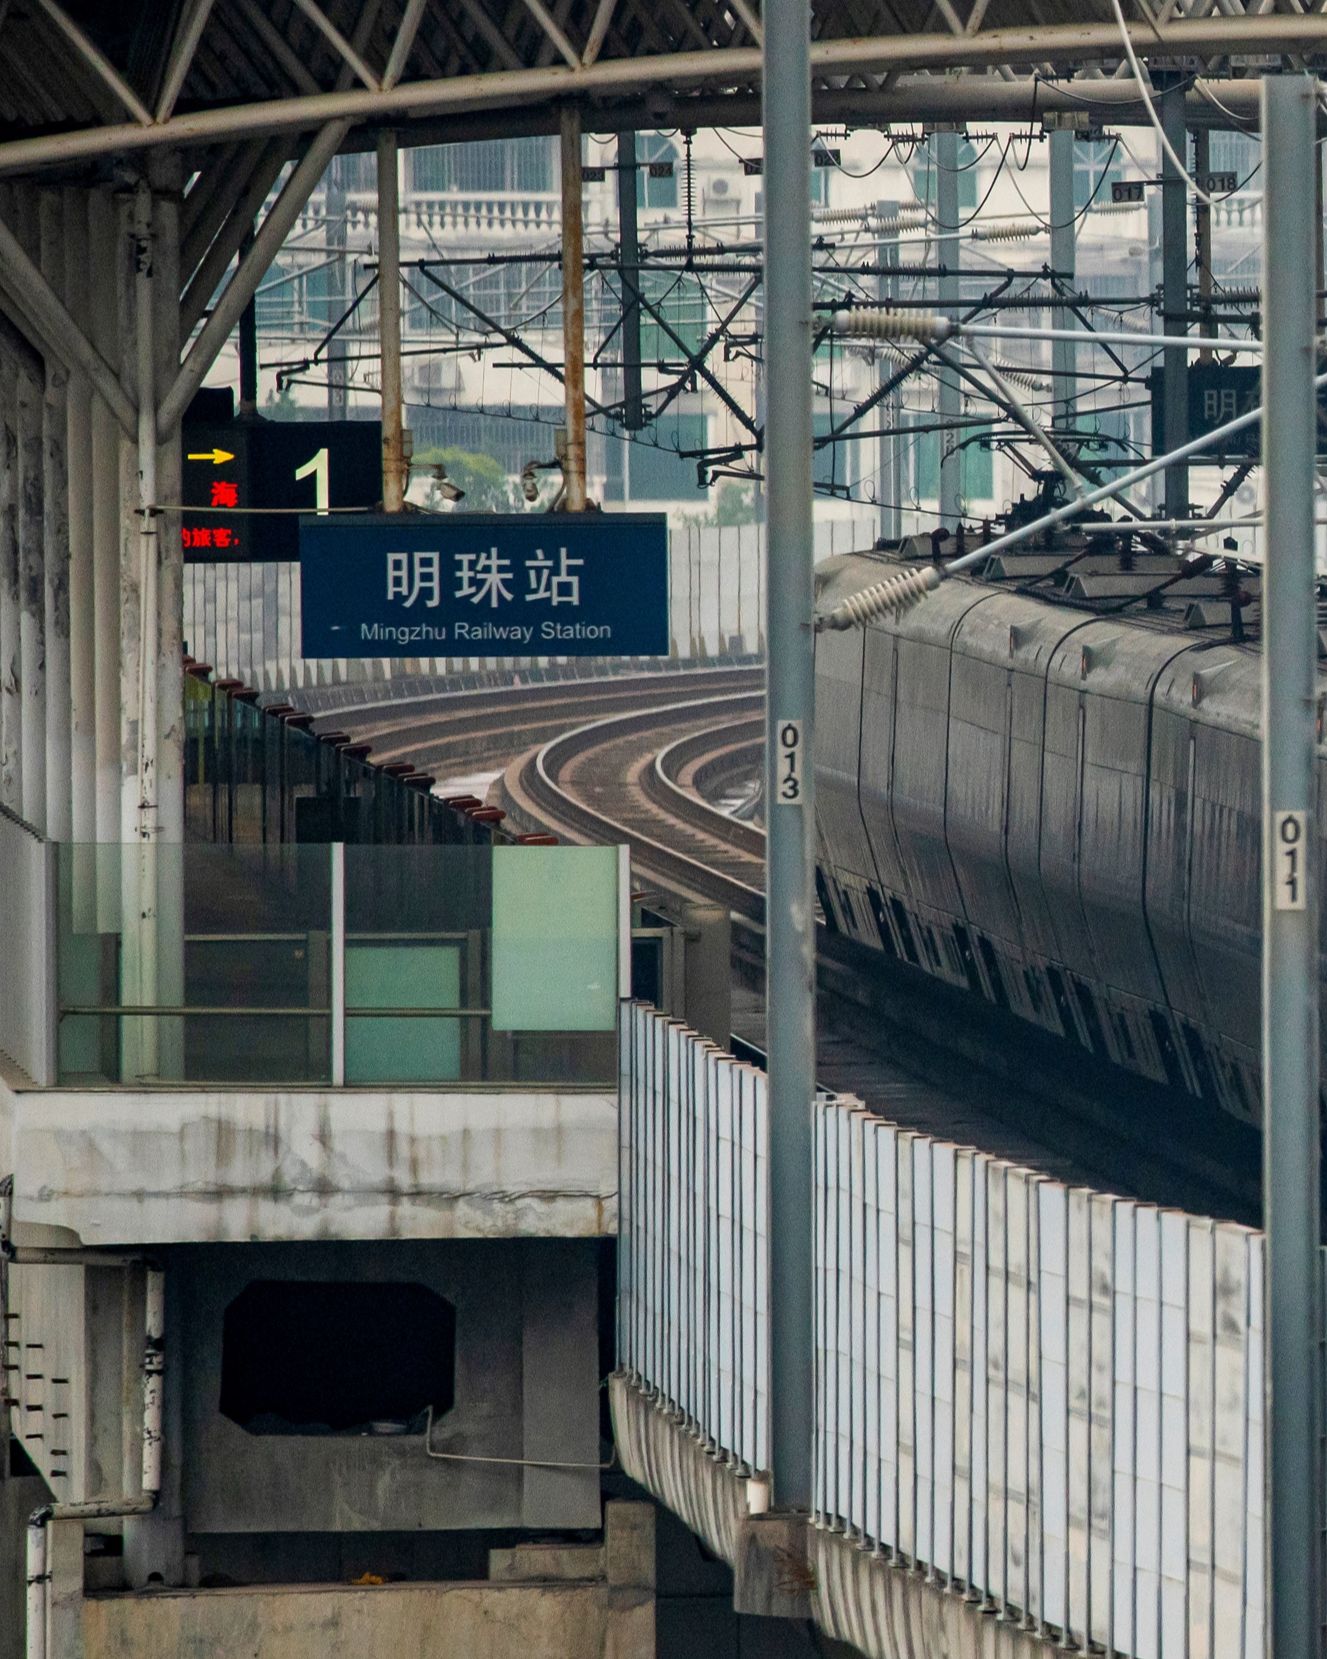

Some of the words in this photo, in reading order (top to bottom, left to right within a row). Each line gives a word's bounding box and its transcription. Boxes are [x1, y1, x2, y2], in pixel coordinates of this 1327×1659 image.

[1112, 185, 1143, 201] 017
[1206, 176, 1237, 191] 018
[210, 481, 239, 508] 海
[294, 447, 330, 516] 1
[386, 547, 585, 608] 明珠站
[360, 621, 447, 644] Mingzhu
[453, 621, 534, 644] Railway
[540, 620, 612, 641] Station
[781, 722, 800, 800] 013
[1280, 815, 1302, 904] 011
